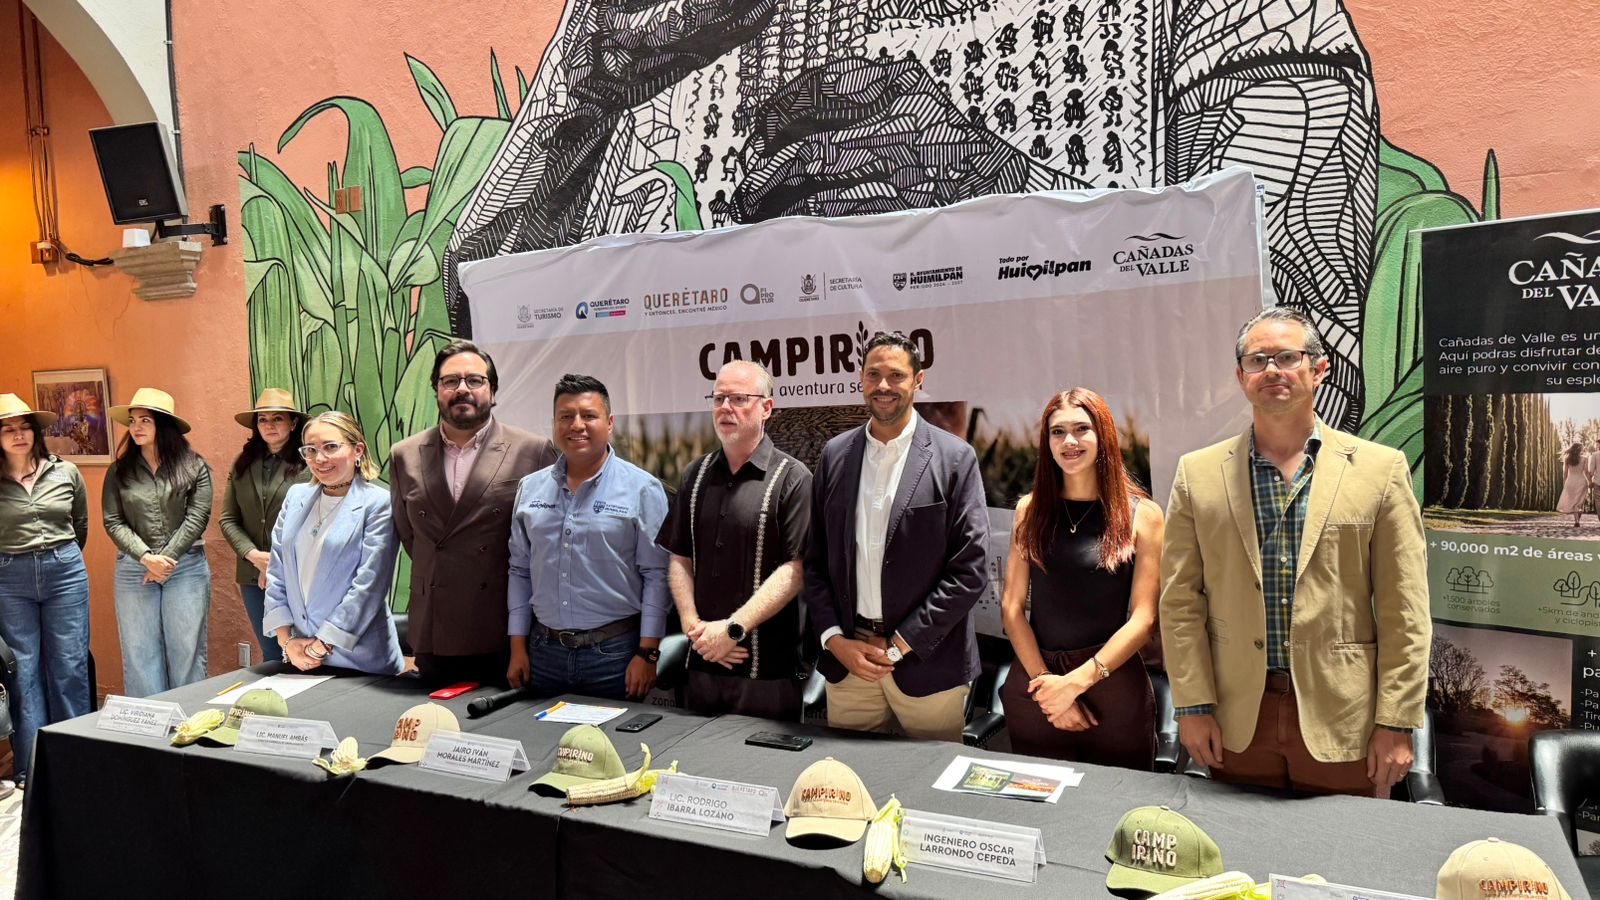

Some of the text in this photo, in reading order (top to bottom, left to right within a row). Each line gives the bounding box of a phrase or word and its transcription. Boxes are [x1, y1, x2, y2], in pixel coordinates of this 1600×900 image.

[1016, 255, 1029, 263] por
[1113, 244, 1194, 265] CAÑADAS
[1136, 260, 1190, 277] VALLE
[910, 271, 963, 285] HUIMILPAN
[590, 298, 629, 308] QUERÉTARO
[644, 287, 728, 310] QUERÉTARO
[1522, 284, 1600, 310] DEL VA
[534, 312, 562, 320] TURISMO
[1439, 335, 1494, 348] Cañadas
[1499, 334, 1516, 345] de
[1522, 332, 1556, 344] Valle
[1561, 333, 1577, 342] es
[1439, 350, 1469, 362] Aquí
[1520, 347, 1582, 358] disfrutar
[1439, 361, 1600, 375] aire puro y convivir con
[780, 381, 845, 397] aventura
[1546, 377, 1562, 386] su
[1440, 541, 1489, 554] 90,000
[1494, 545, 1519, 556] m2
[1523, 546, 1542, 558] de
[1547, 548, 1593, 562] áreas
[1448, 603, 1500, 614] conservados
[453, 745, 488, 757] JAIRO IVÁN
[437, 751, 466, 763] MORALES
[467, 756, 500, 769] MARTÍNEZ
[669, 793, 728, 809] LIC. RODRIGO
[666, 803, 734, 821] IBARRA LOZANO
[923, 833, 977, 849] INGENIERO
[979, 843, 1014, 855] OSCAR
[1134, 829, 1177, 850] CAMP
[920, 843, 1016, 867] LARRONDO CEPEDA
